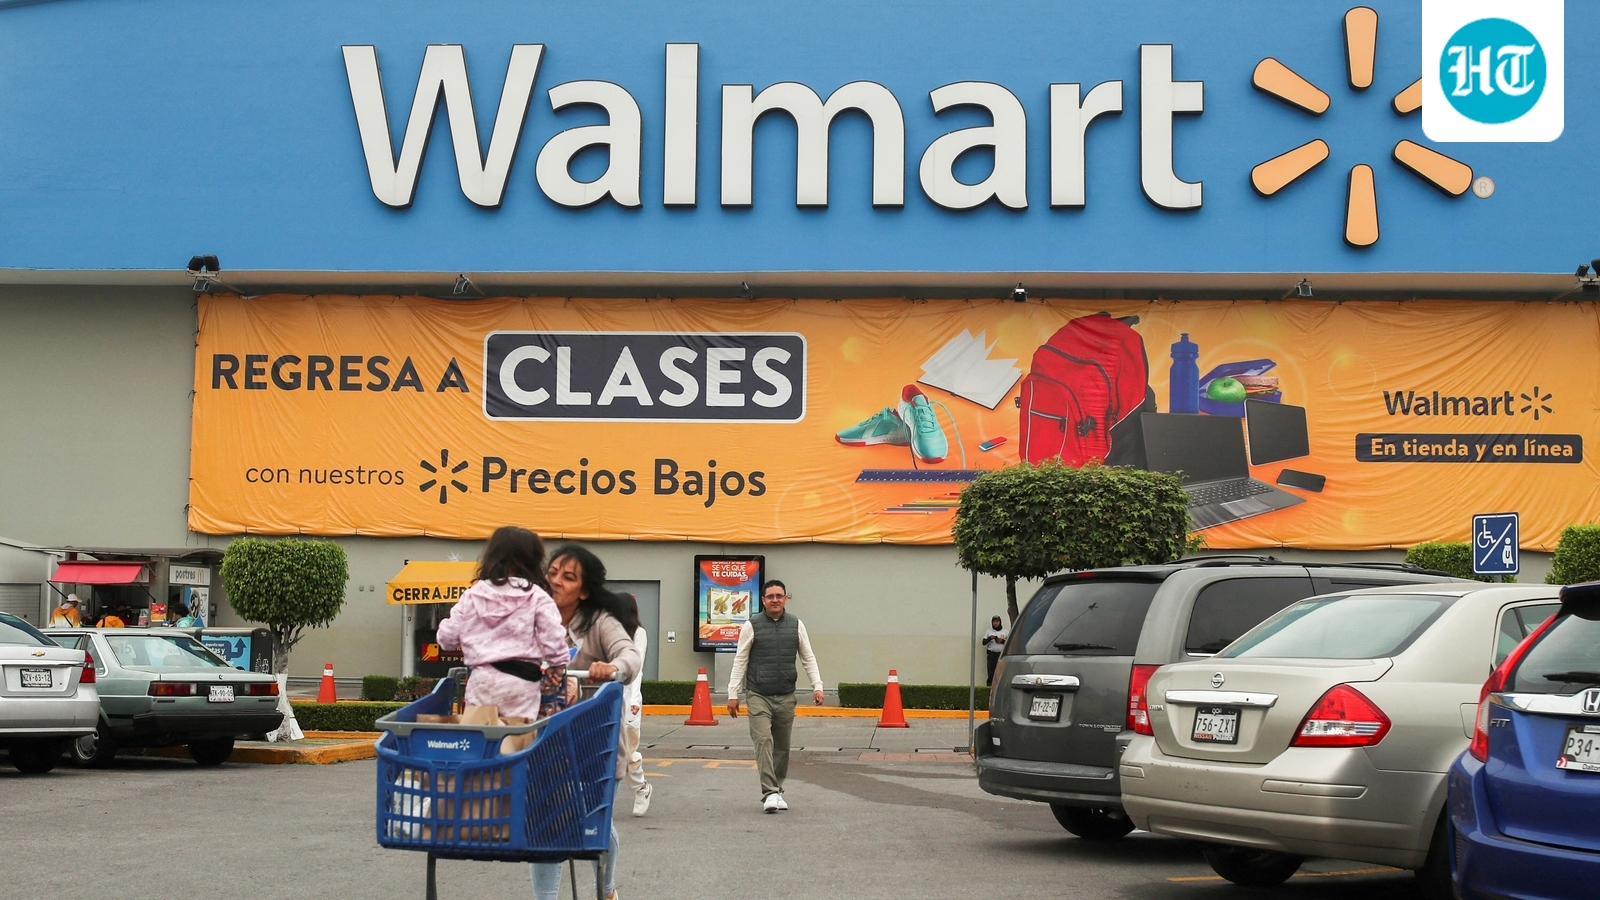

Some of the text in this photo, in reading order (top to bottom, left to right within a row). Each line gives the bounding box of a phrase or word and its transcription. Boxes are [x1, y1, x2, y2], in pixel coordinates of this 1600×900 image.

[341, 43, 1204, 210] Walmart
[211, 353, 470, 393] REGRESA A
[499, 345, 793, 408] CLASES
[1383, 391, 1515, 416] Walmart
[1371, 438, 1573, 461] En tienda y en línea
[245, 465, 405, 485] con nuestros
[482, 456, 767, 508] Precios Bajos
[175, 568, 196, 582] postres
[393, 586, 467, 601] CERRAJER
[1196, 717, 1235, 733] 756-ZXT
[1490, 718, 1511, 727] FIT
[427, 740, 459, 749] Walmart
